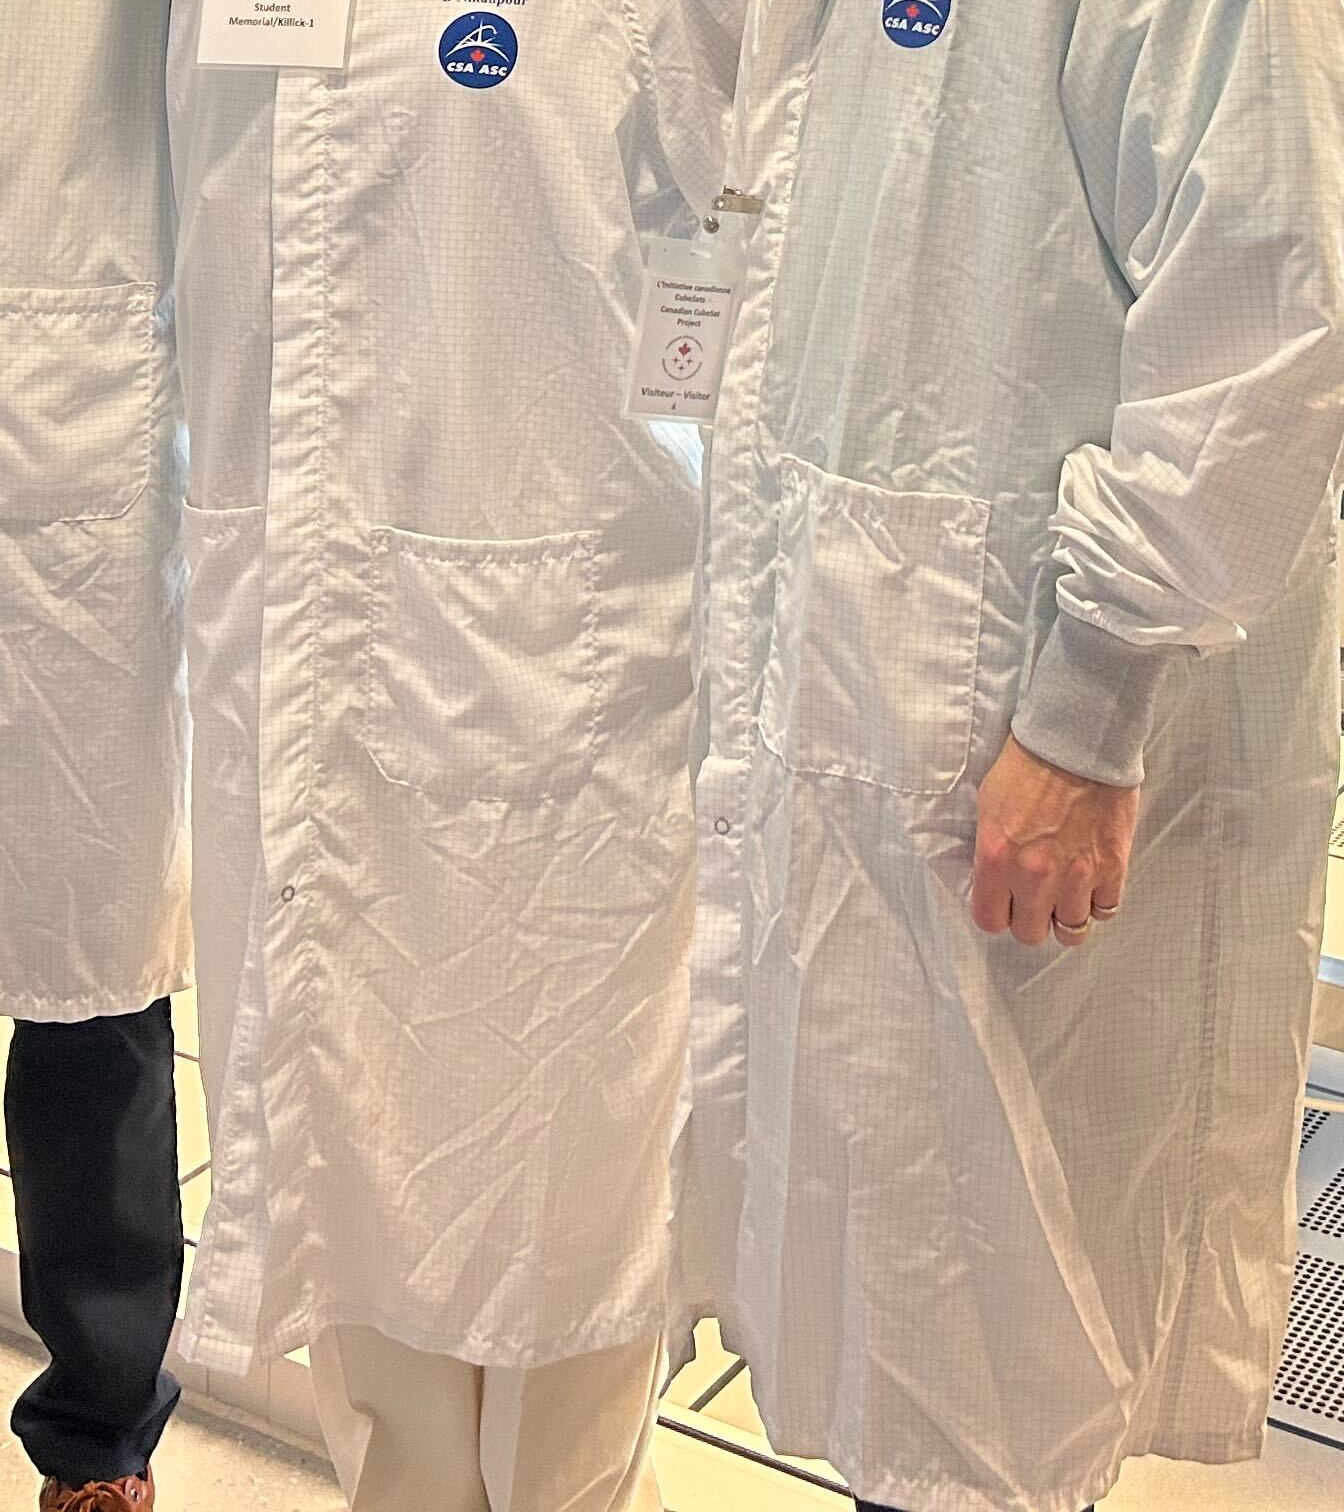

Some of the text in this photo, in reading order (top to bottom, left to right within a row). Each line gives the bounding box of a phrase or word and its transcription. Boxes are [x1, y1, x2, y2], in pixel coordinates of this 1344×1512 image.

[254, 2, 291, 13] Student
[228, 16, 314, 28] Memorial/Killick-1
[884, 16, 940, 36] CSA ASC
[446, 61, 508, 77] CSA ASC
[640, 386, 675, 399] Visiteur
